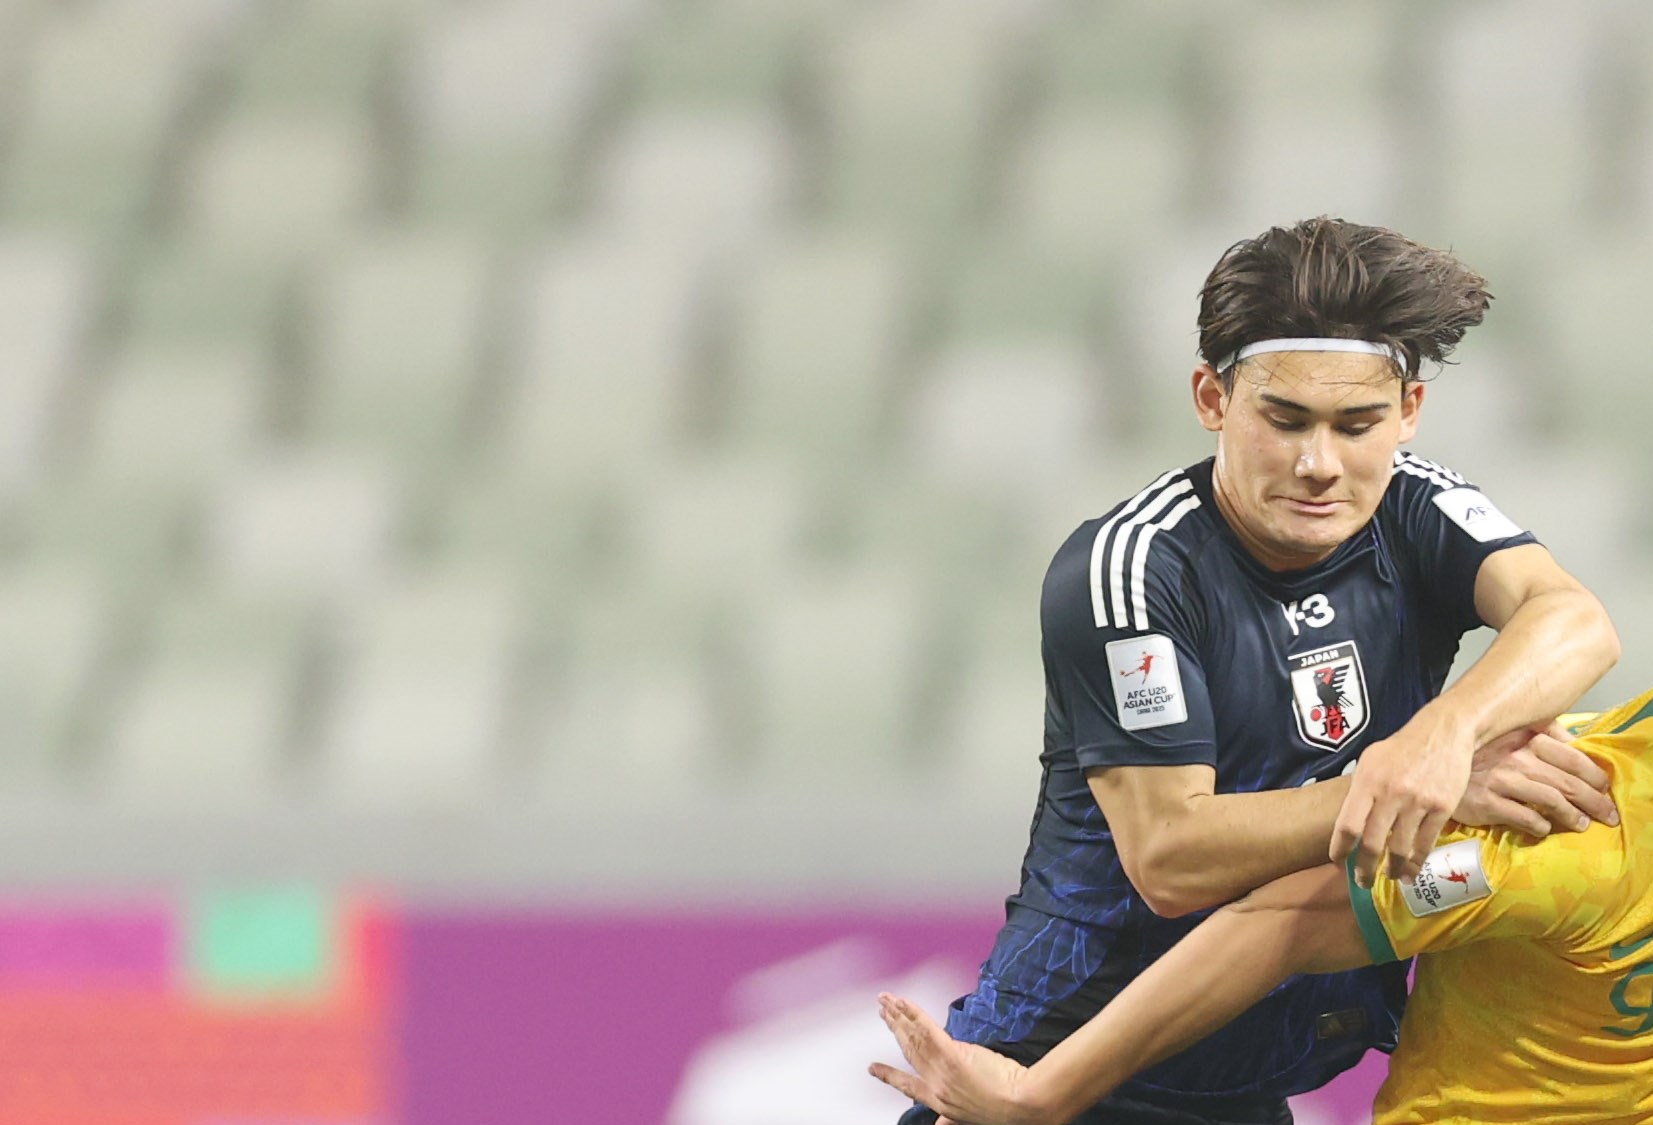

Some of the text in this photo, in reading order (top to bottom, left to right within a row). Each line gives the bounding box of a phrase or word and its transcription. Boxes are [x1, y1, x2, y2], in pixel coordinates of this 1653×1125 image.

[1281, 593, 1335, 636] Y-3
[1300, 650, 1339, 667] JAPAN
[1123, 694, 1174, 709] ASIAN CUP
[1127, 686, 1167, 700] AFC U20
[1320, 716, 1350, 736] JFA
